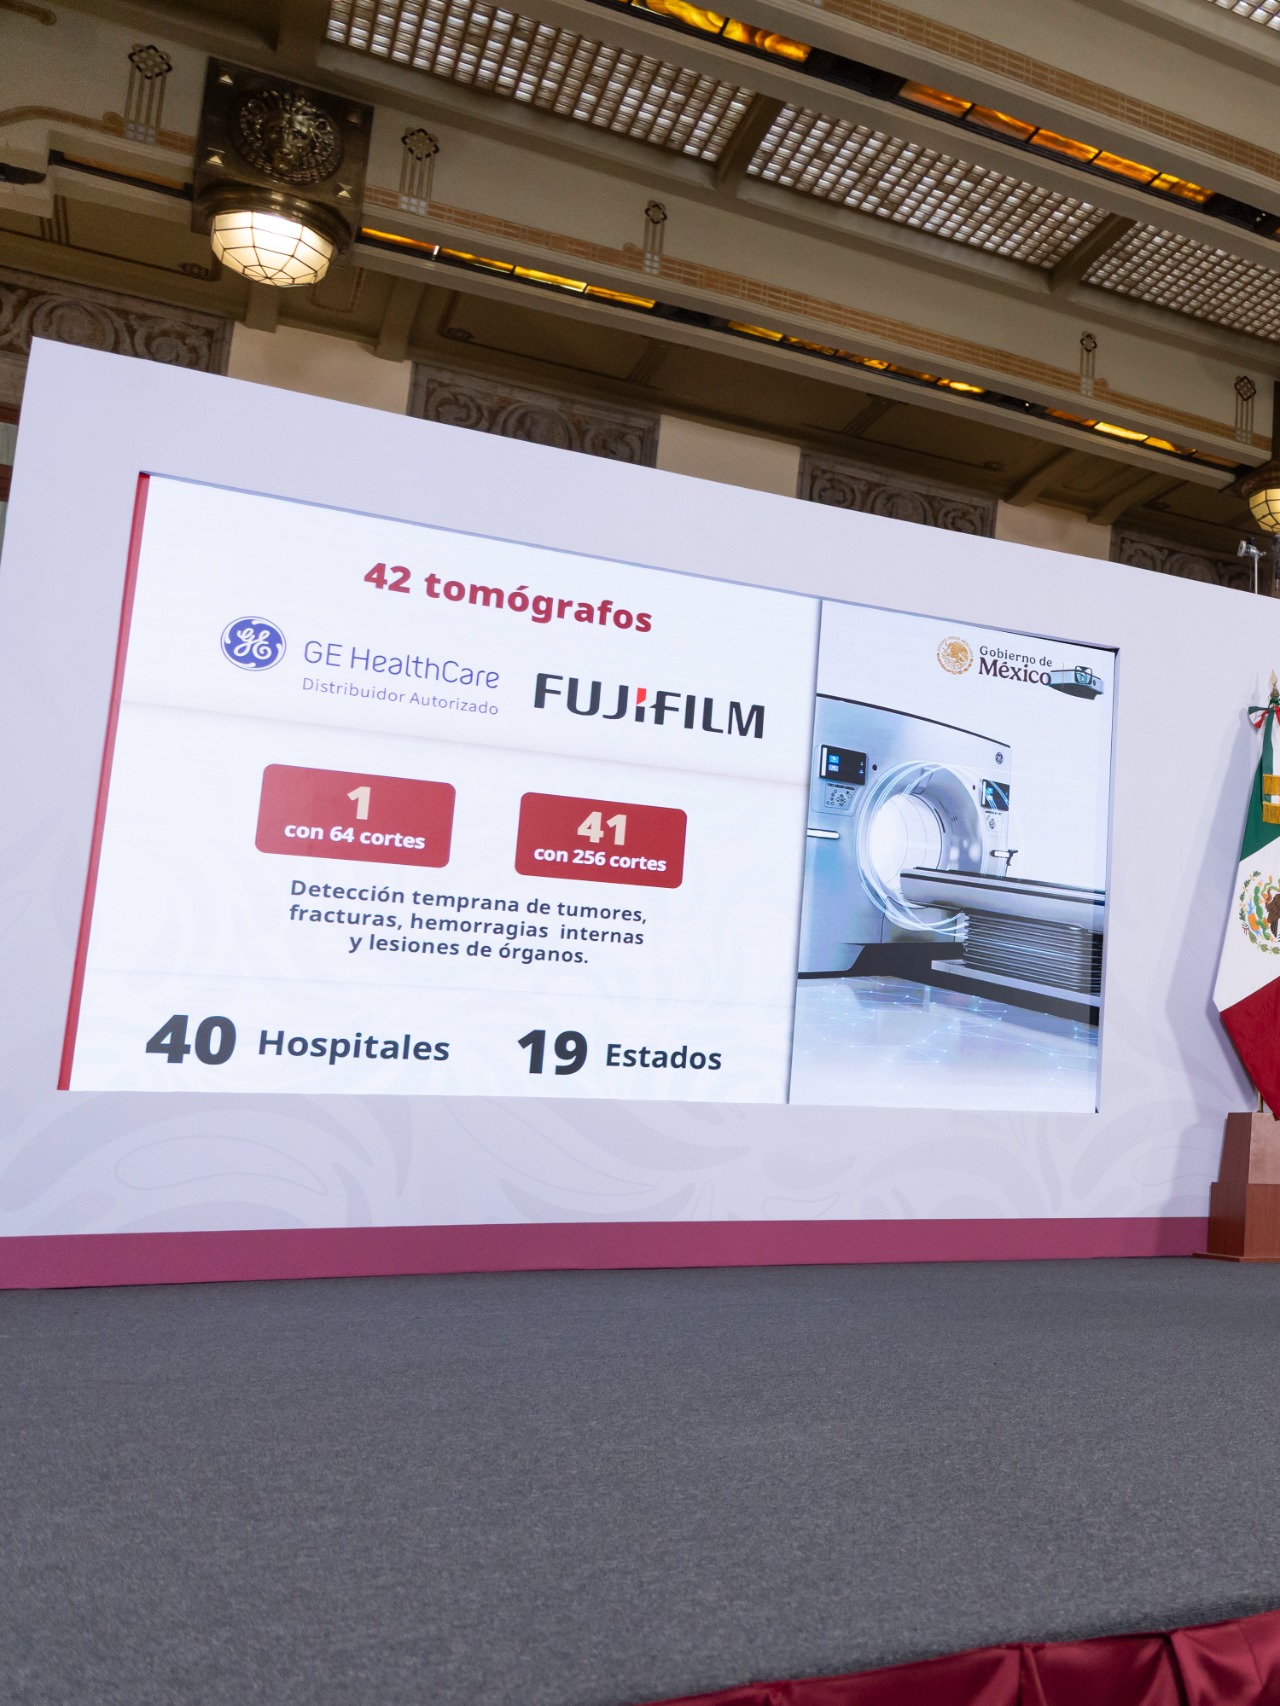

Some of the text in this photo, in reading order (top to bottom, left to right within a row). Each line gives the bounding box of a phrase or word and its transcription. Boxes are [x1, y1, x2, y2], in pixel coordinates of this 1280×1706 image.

[364, 563, 653, 633] 42 tomógrafos
[304, 640, 500, 689] GE HealthCare
[978, 656, 1052, 686] México
[979, 645, 1036, 665] Gobierno
[1039, 656, 1053, 668] de
[302, 677, 499, 716] Distribuidor Autorizado
[533, 672, 765, 739] FUJIFILM
[347, 786, 371, 821] 1
[284, 824, 426, 850] con 64 cortes
[577, 811, 627, 846] 41
[534, 848, 667, 872] con 256 cortes
[290, 879, 647, 925] Detección temprana de tumores,
[289, 904, 645, 945] fracturas, hemorragias internas
[348, 934, 589, 965] y lesiones de órganos.
[145, 1014, 451, 1065] 40 Hospitales
[517, 1029, 723, 1075] 19 Estados
